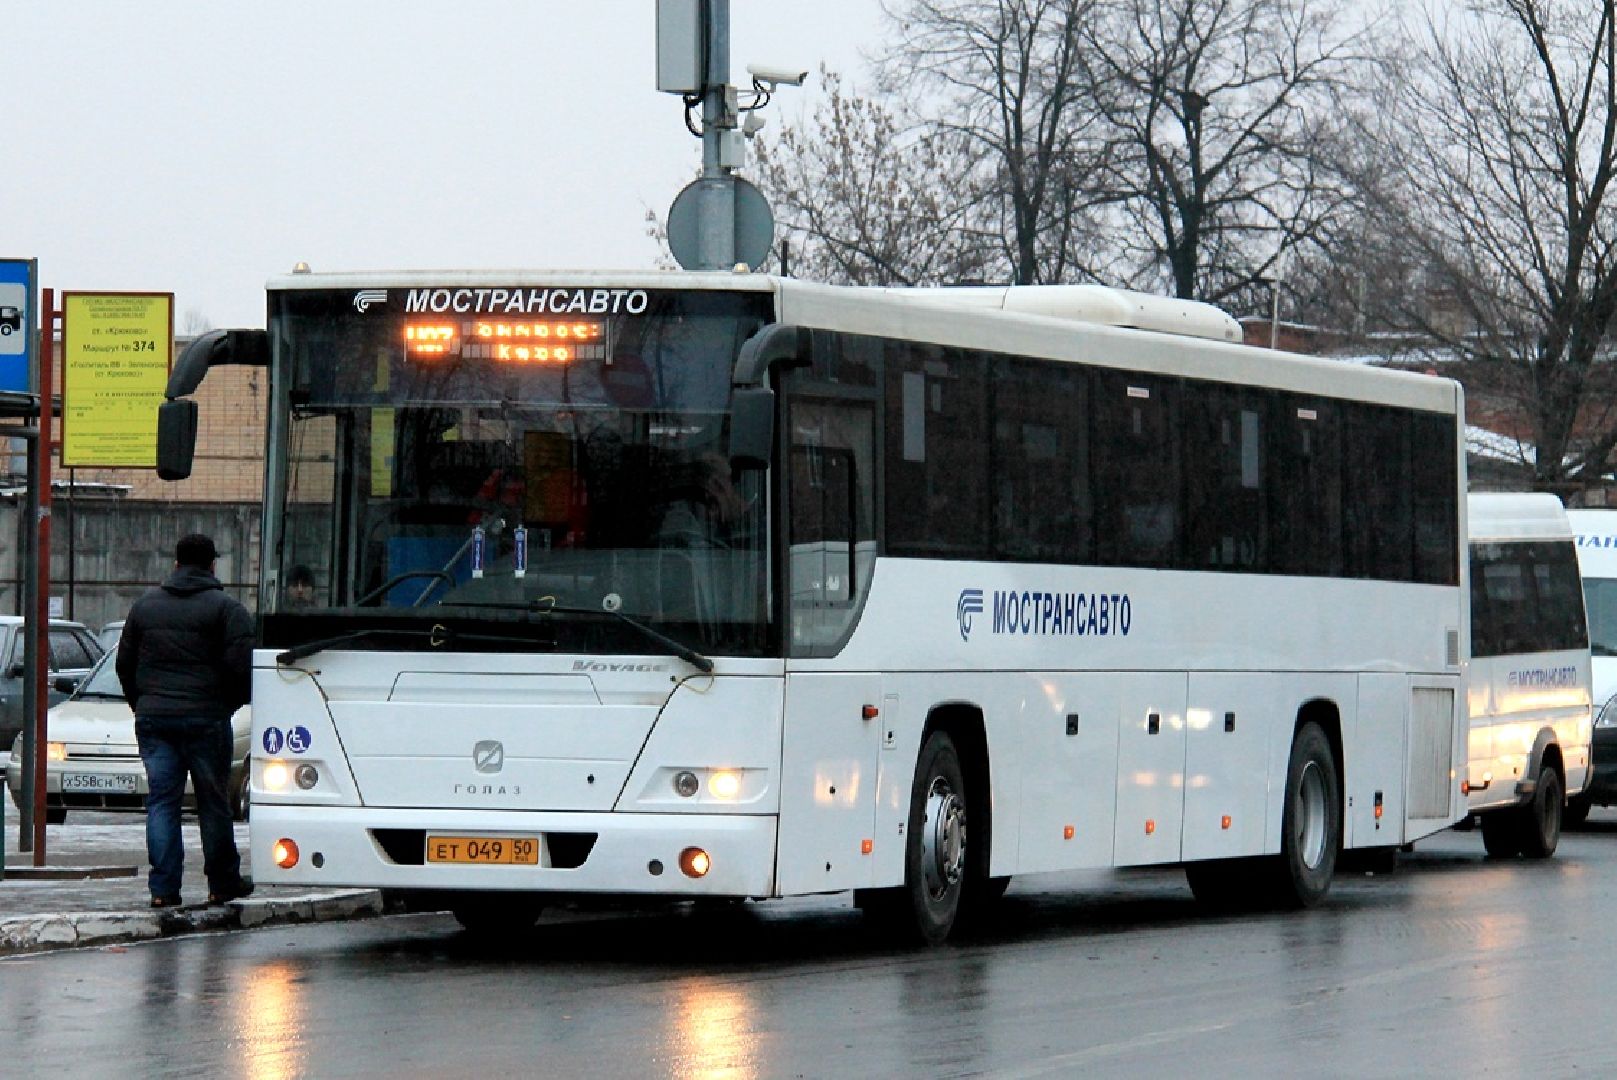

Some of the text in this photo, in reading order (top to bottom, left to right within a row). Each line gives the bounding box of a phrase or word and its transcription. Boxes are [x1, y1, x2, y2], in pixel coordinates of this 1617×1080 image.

[405, 288, 648, 314] МОСТРАНСАВТО
[82, 344, 119, 353] Маршрут
[132, 340, 155, 352] 374
[992, 590, 1132, 636] МОСТРАНСАВТО
[454, 783, 522, 795] ГОЛАЗ
[467, 840, 503, 860] 049
[513, 839, 532, 855] 50
